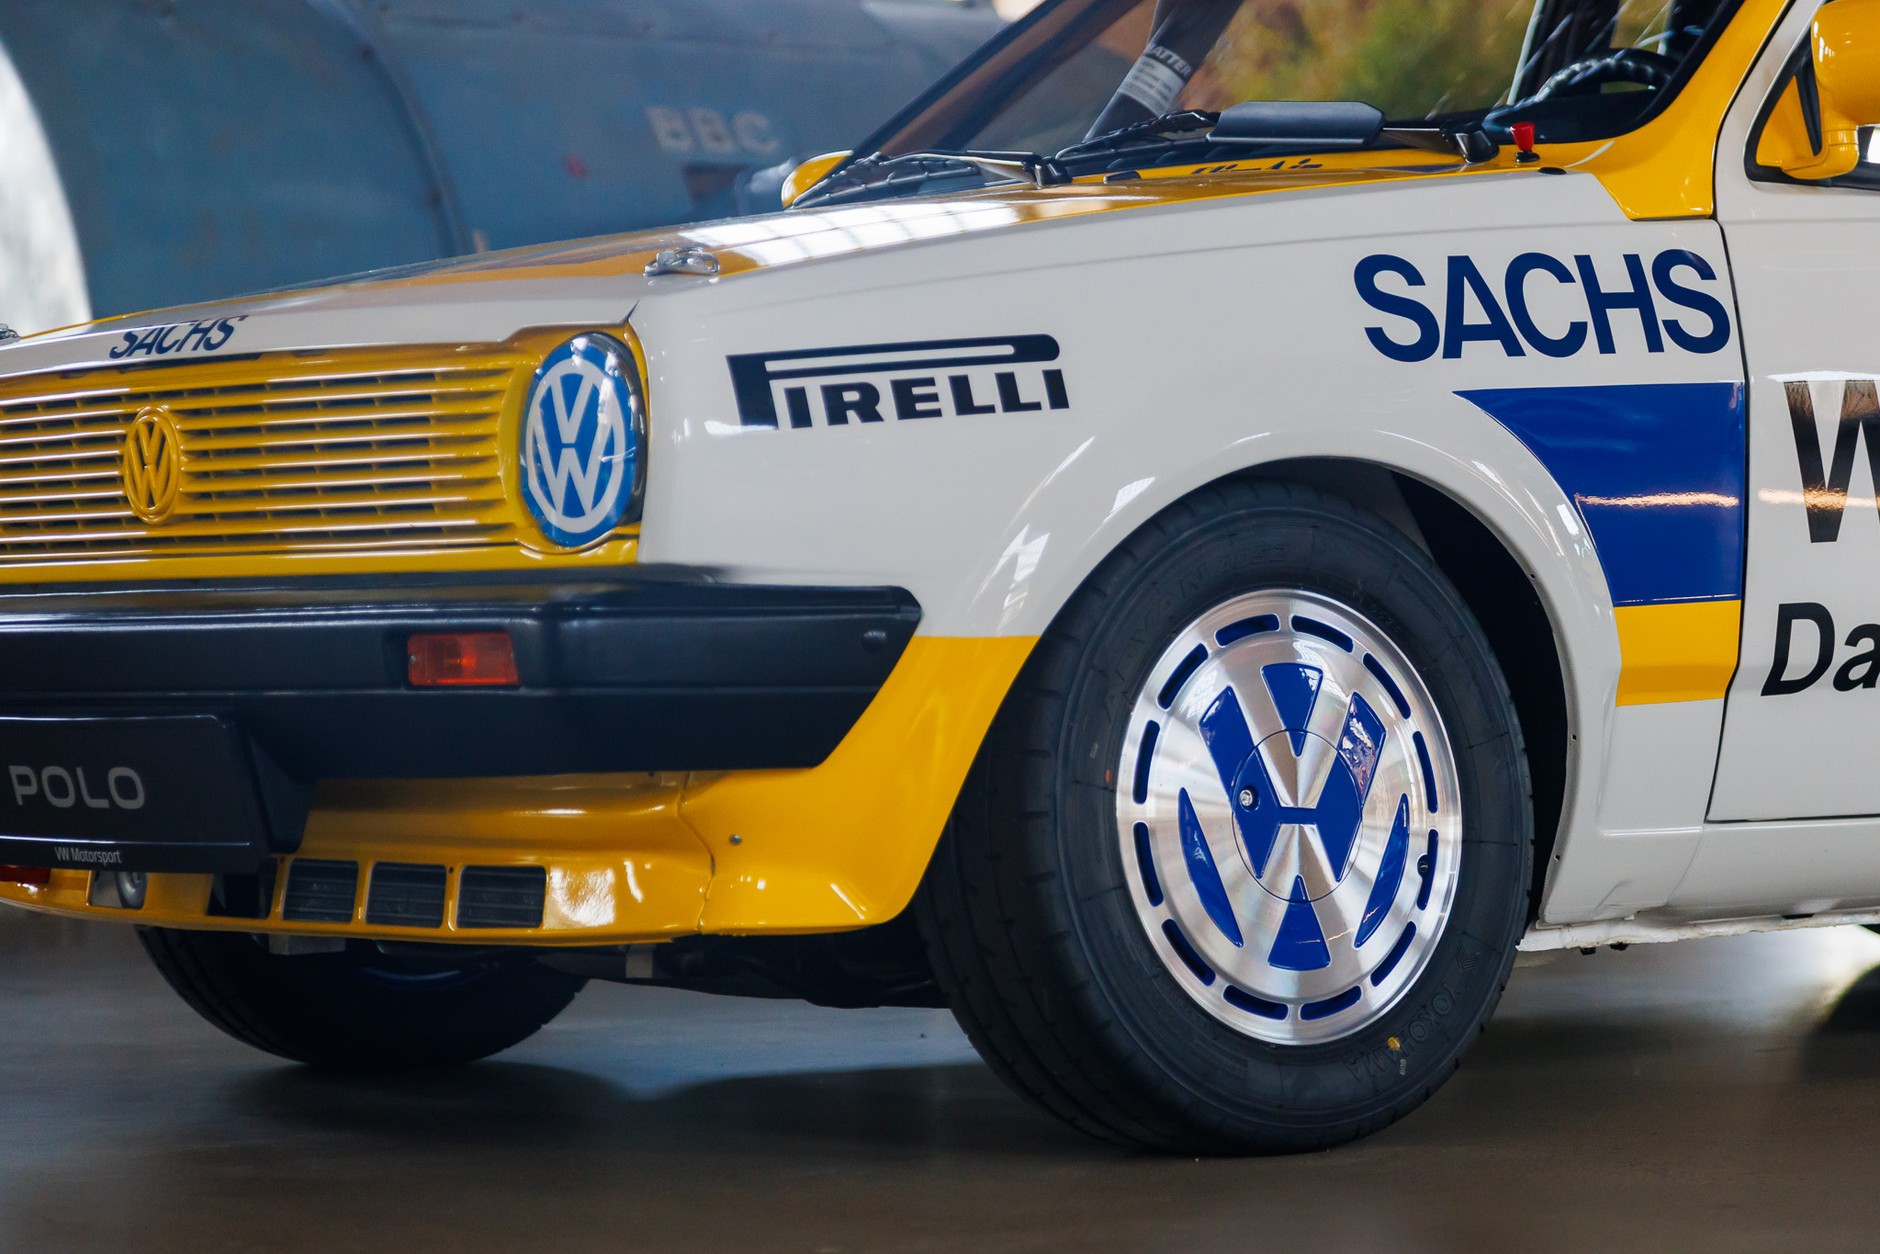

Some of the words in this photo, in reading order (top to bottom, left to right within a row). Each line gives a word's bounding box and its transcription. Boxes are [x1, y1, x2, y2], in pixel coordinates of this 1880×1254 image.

[645, 104, 778, 154] BBC
[108, 314, 249, 359] SACHS
[1353, 249, 1731, 362] SACHS
[725, 333, 1070, 431] PIRELLI
[1761, 602, 1880, 697] Da
[8, 764, 146, 810] POLO
[55, 847, 70, 861] VW
[71, 848, 122, 867] Motorsport
[1344, 984, 1464, 1082] YOKOHAMA
